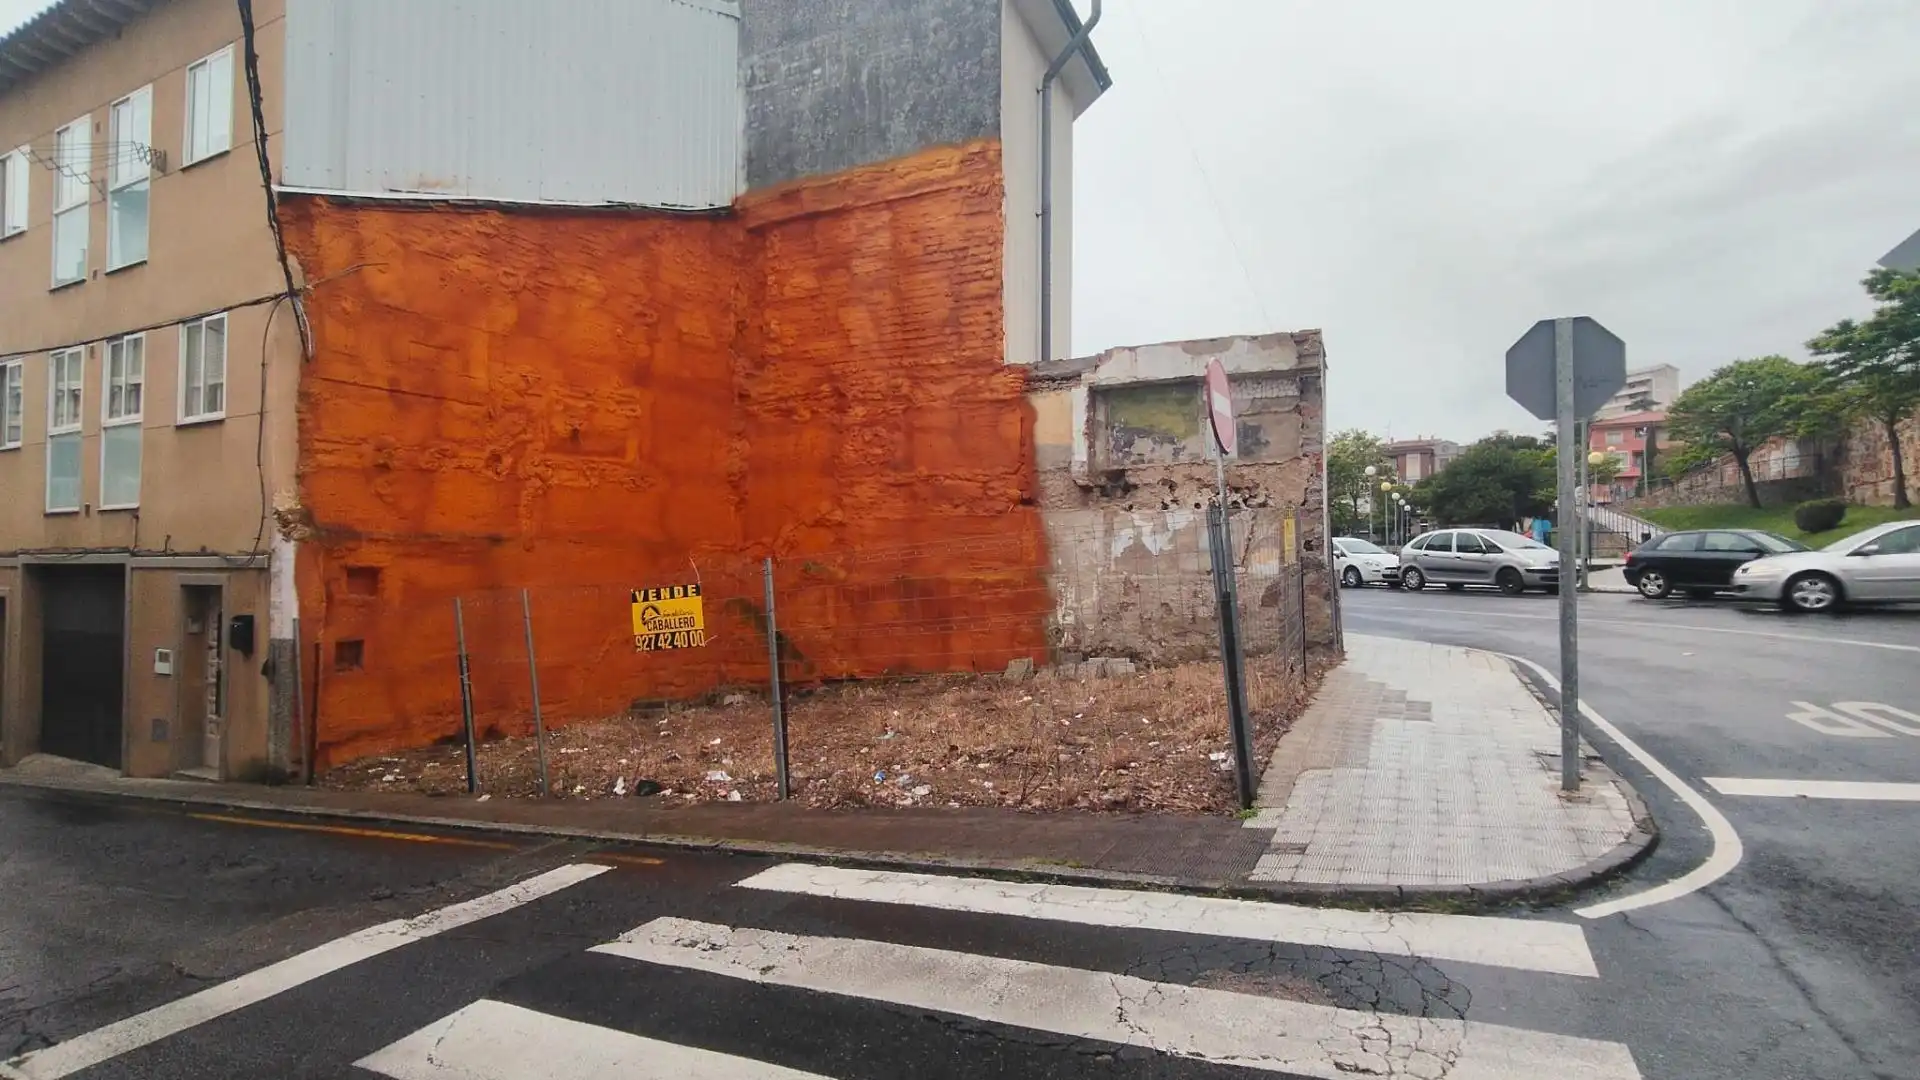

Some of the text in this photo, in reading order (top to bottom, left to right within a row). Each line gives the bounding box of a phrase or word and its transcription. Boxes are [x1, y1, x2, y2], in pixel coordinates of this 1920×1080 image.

[636, 585, 696, 602] VENDE
[647, 617, 695, 631] CABALLERO
[635, 630, 705, 650] 927 42 40 00
